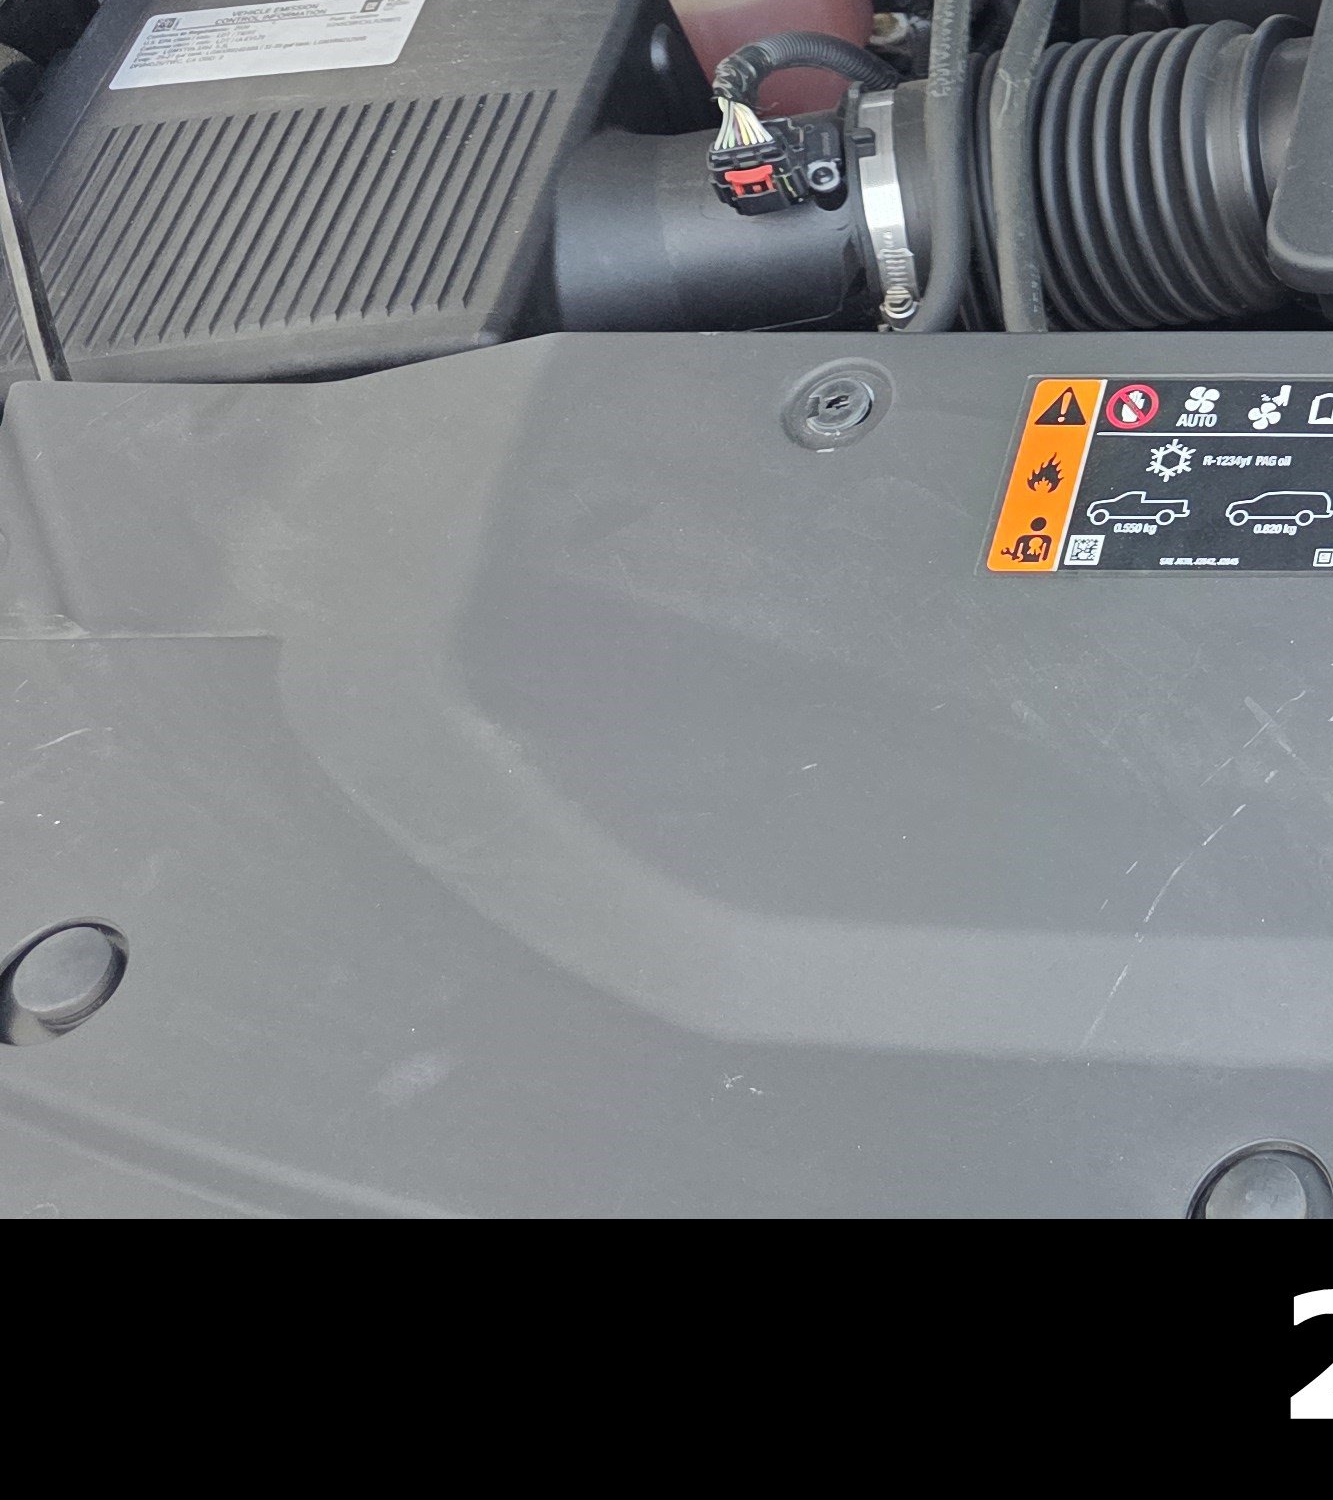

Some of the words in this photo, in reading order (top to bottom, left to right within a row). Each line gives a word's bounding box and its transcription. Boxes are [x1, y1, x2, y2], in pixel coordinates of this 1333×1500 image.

[231, 9, 272, 17] VEHICLE
[273, 4, 320, 13] EMISSION
[214, 15, 263, 25] CONTROL
[261, 9, 328, 21] INFORMATION
[1176, 413, 1218, 427] AUTO
[1202, 456, 1252, 468] R-1234yf
[1255, 456, 1277, 466] PAG
[1278, 456, 1291, 466] oil
[1143, 523, 1157, 535] kg
[1283, 524, 1298, 535] kg
